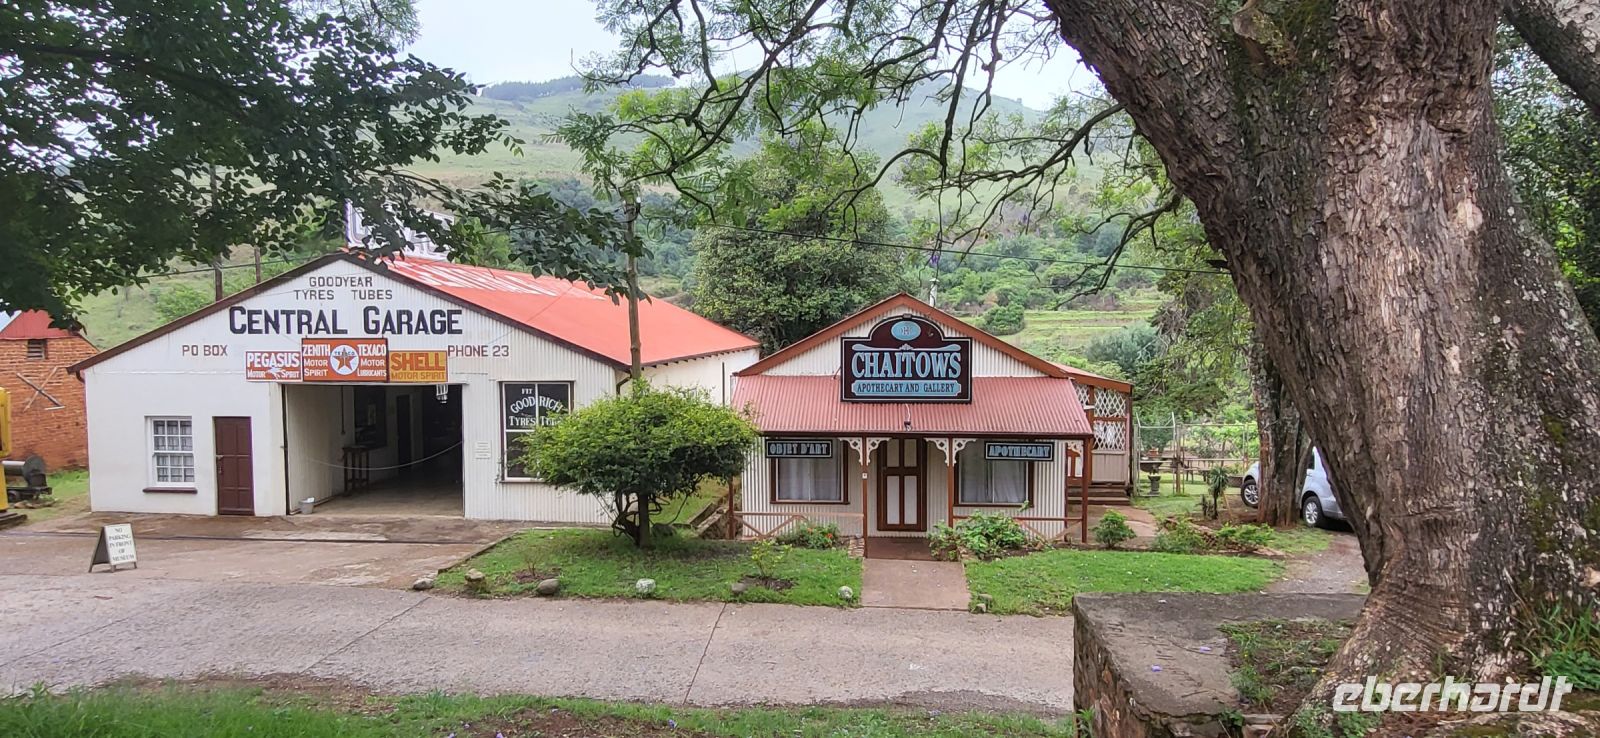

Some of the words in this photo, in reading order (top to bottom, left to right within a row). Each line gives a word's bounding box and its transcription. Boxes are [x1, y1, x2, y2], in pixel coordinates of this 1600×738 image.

[309, 276, 373, 288] GOODYEAR
[294, 289, 335, 300] TYRES
[351, 289, 393, 300] TUBES
[229, 306, 348, 335] CENTRAL
[363, 305, 463, 335] GARAGE
[182, 344, 199, 356] PO
[203, 344, 228, 356] BOX
[303, 344, 331, 356] ZENITH
[357, 344, 386, 356] TEXACO
[447, 344, 489, 357] PHONE
[492, 344, 510, 357] 23
[247, 352, 300, 368] PEGASUS
[304, 358, 329, 366] MOTOR
[360, 358, 385, 366] MOTOR
[390, 352, 446, 371] SHELL
[851, 351, 962, 378] CHAITOWS
[247, 369, 266, 378] MOTOR
[280, 369, 300, 378] SPIRIT
[304, 368, 329, 376] SPIRIT
[357, 369, 387, 377] LUBRICANTS
[391, 371, 418, 380] MOTOR
[420, 371, 445, 380] SPIRIT
[857, 383, 903, 393] APOTHECARY
[905, 383, 920, 393] AND
[923, 383, 955, 393] GALLERY
[509, 415, 536, 426] TYRES
[769, 443, 798, 455] OBJET
[800, 443, 828, 455] D'ART
[988, 445, 1050, 457] APOTHECARY
